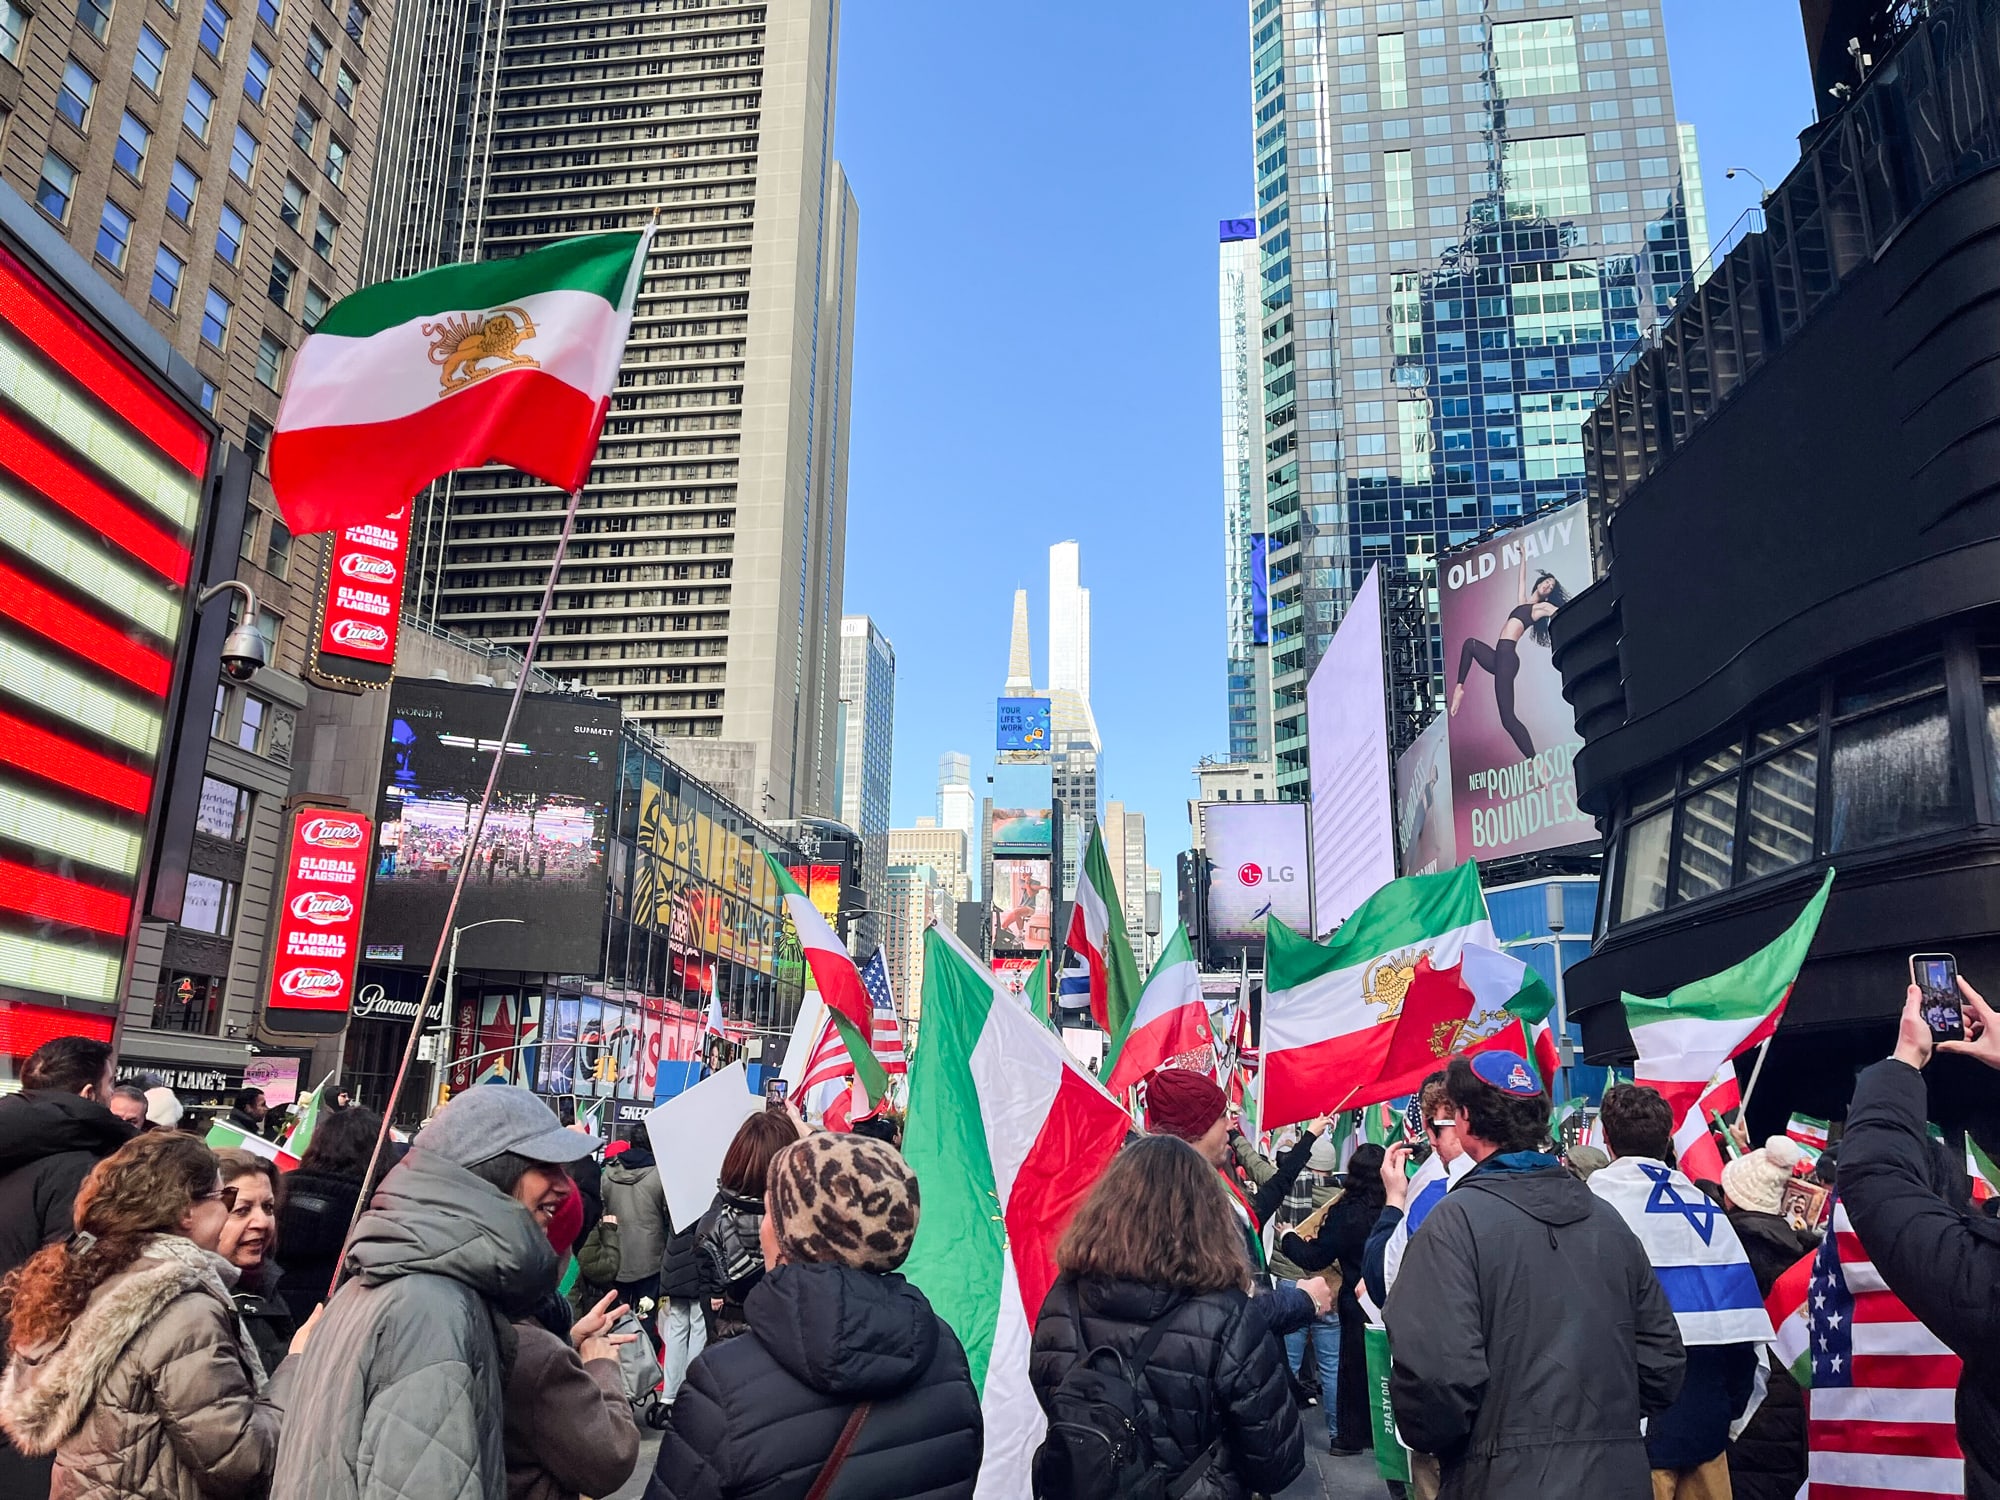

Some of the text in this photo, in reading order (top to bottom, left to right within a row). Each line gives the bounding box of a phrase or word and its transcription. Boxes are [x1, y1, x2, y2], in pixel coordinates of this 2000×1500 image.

[345, 532, 398, 551] FLAGSHIP
[347, 524, 398, 542] LOBAL
[1448, 517, 1574, 590] OLD NAVY
[342, 553, 394, 577] Cane's
[338, 587, 390, 606] GLOBAL
[336, 597, 390, 616] FLAGSHIP
[332, 620, 387, 643] Cane's
[1001, 706, 1021, 714] YOUR
[1001, 715, 1022, 723] LIFE'S
[1001, 724, 1022, 732] WORK
[1469, 742, 1586, 800] NEW POWERSOF
[303, 819, 359, 844] Cane's
[299, 856, 357, 874] GLOBAL
[1267, 866, 1295, 882] LG
[297, 868, 356, 884] FLAGSHIP
[294, 893, 350, 918] Cane's
[288, 931, 347, 948] GLOBAL
[286, 944, 347, 958] FLAGSHIP
[282, 968, 340, 994] Cane's
[353, 983, 443, 1020] Paramont
[460, 1006, 473, 1046] NEWS
